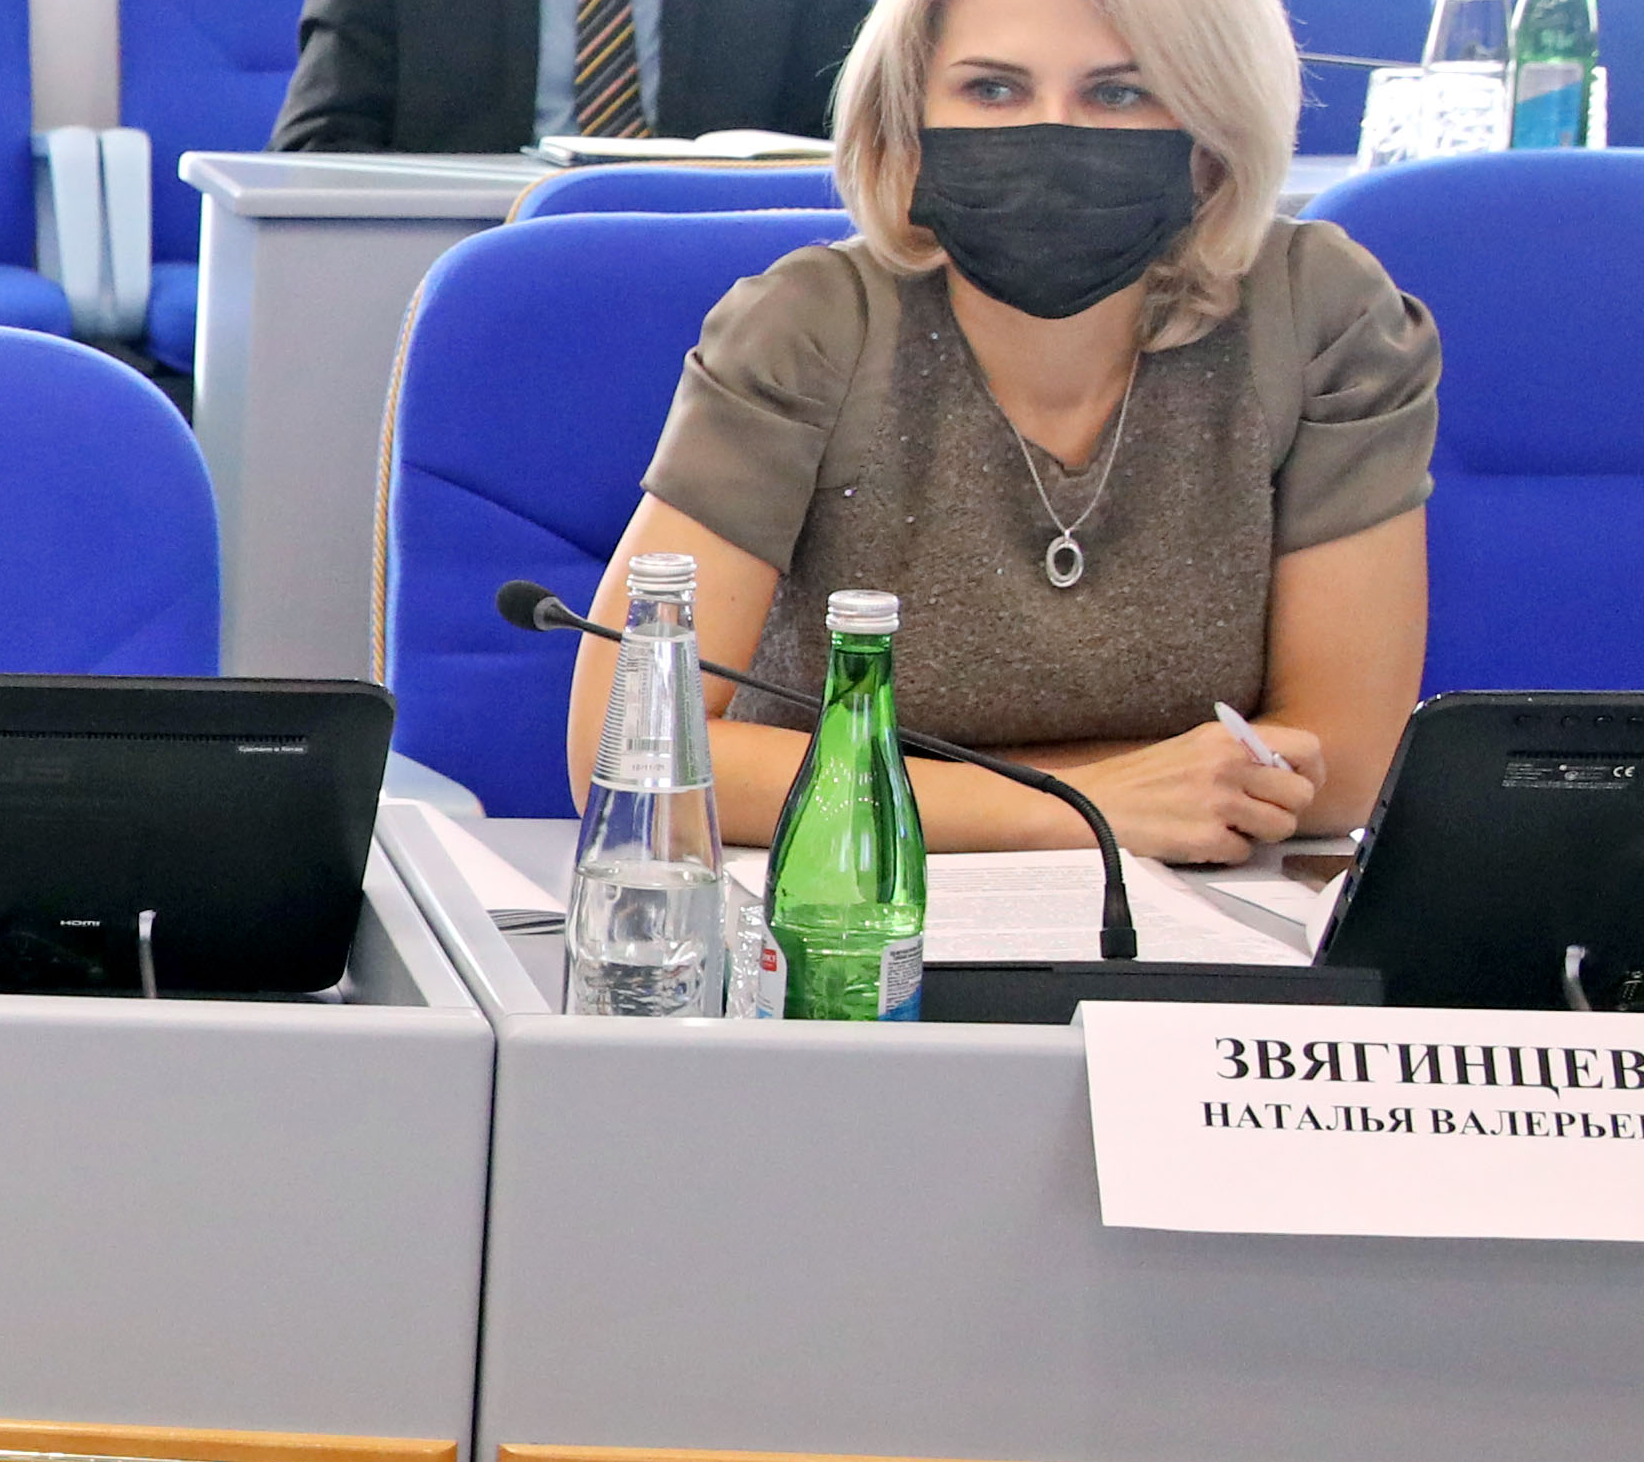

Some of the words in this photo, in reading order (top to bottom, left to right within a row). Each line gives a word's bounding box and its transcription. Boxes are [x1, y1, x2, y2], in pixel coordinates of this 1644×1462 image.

[1215, 1037, 1644, 1099] ЗВЯГИНЦЕВ
[1200, 1101, 1416, 1133] НАТАЛЬЯ
[1429, 1108, 1644, 1140] ВАЛЕРЬЕ
